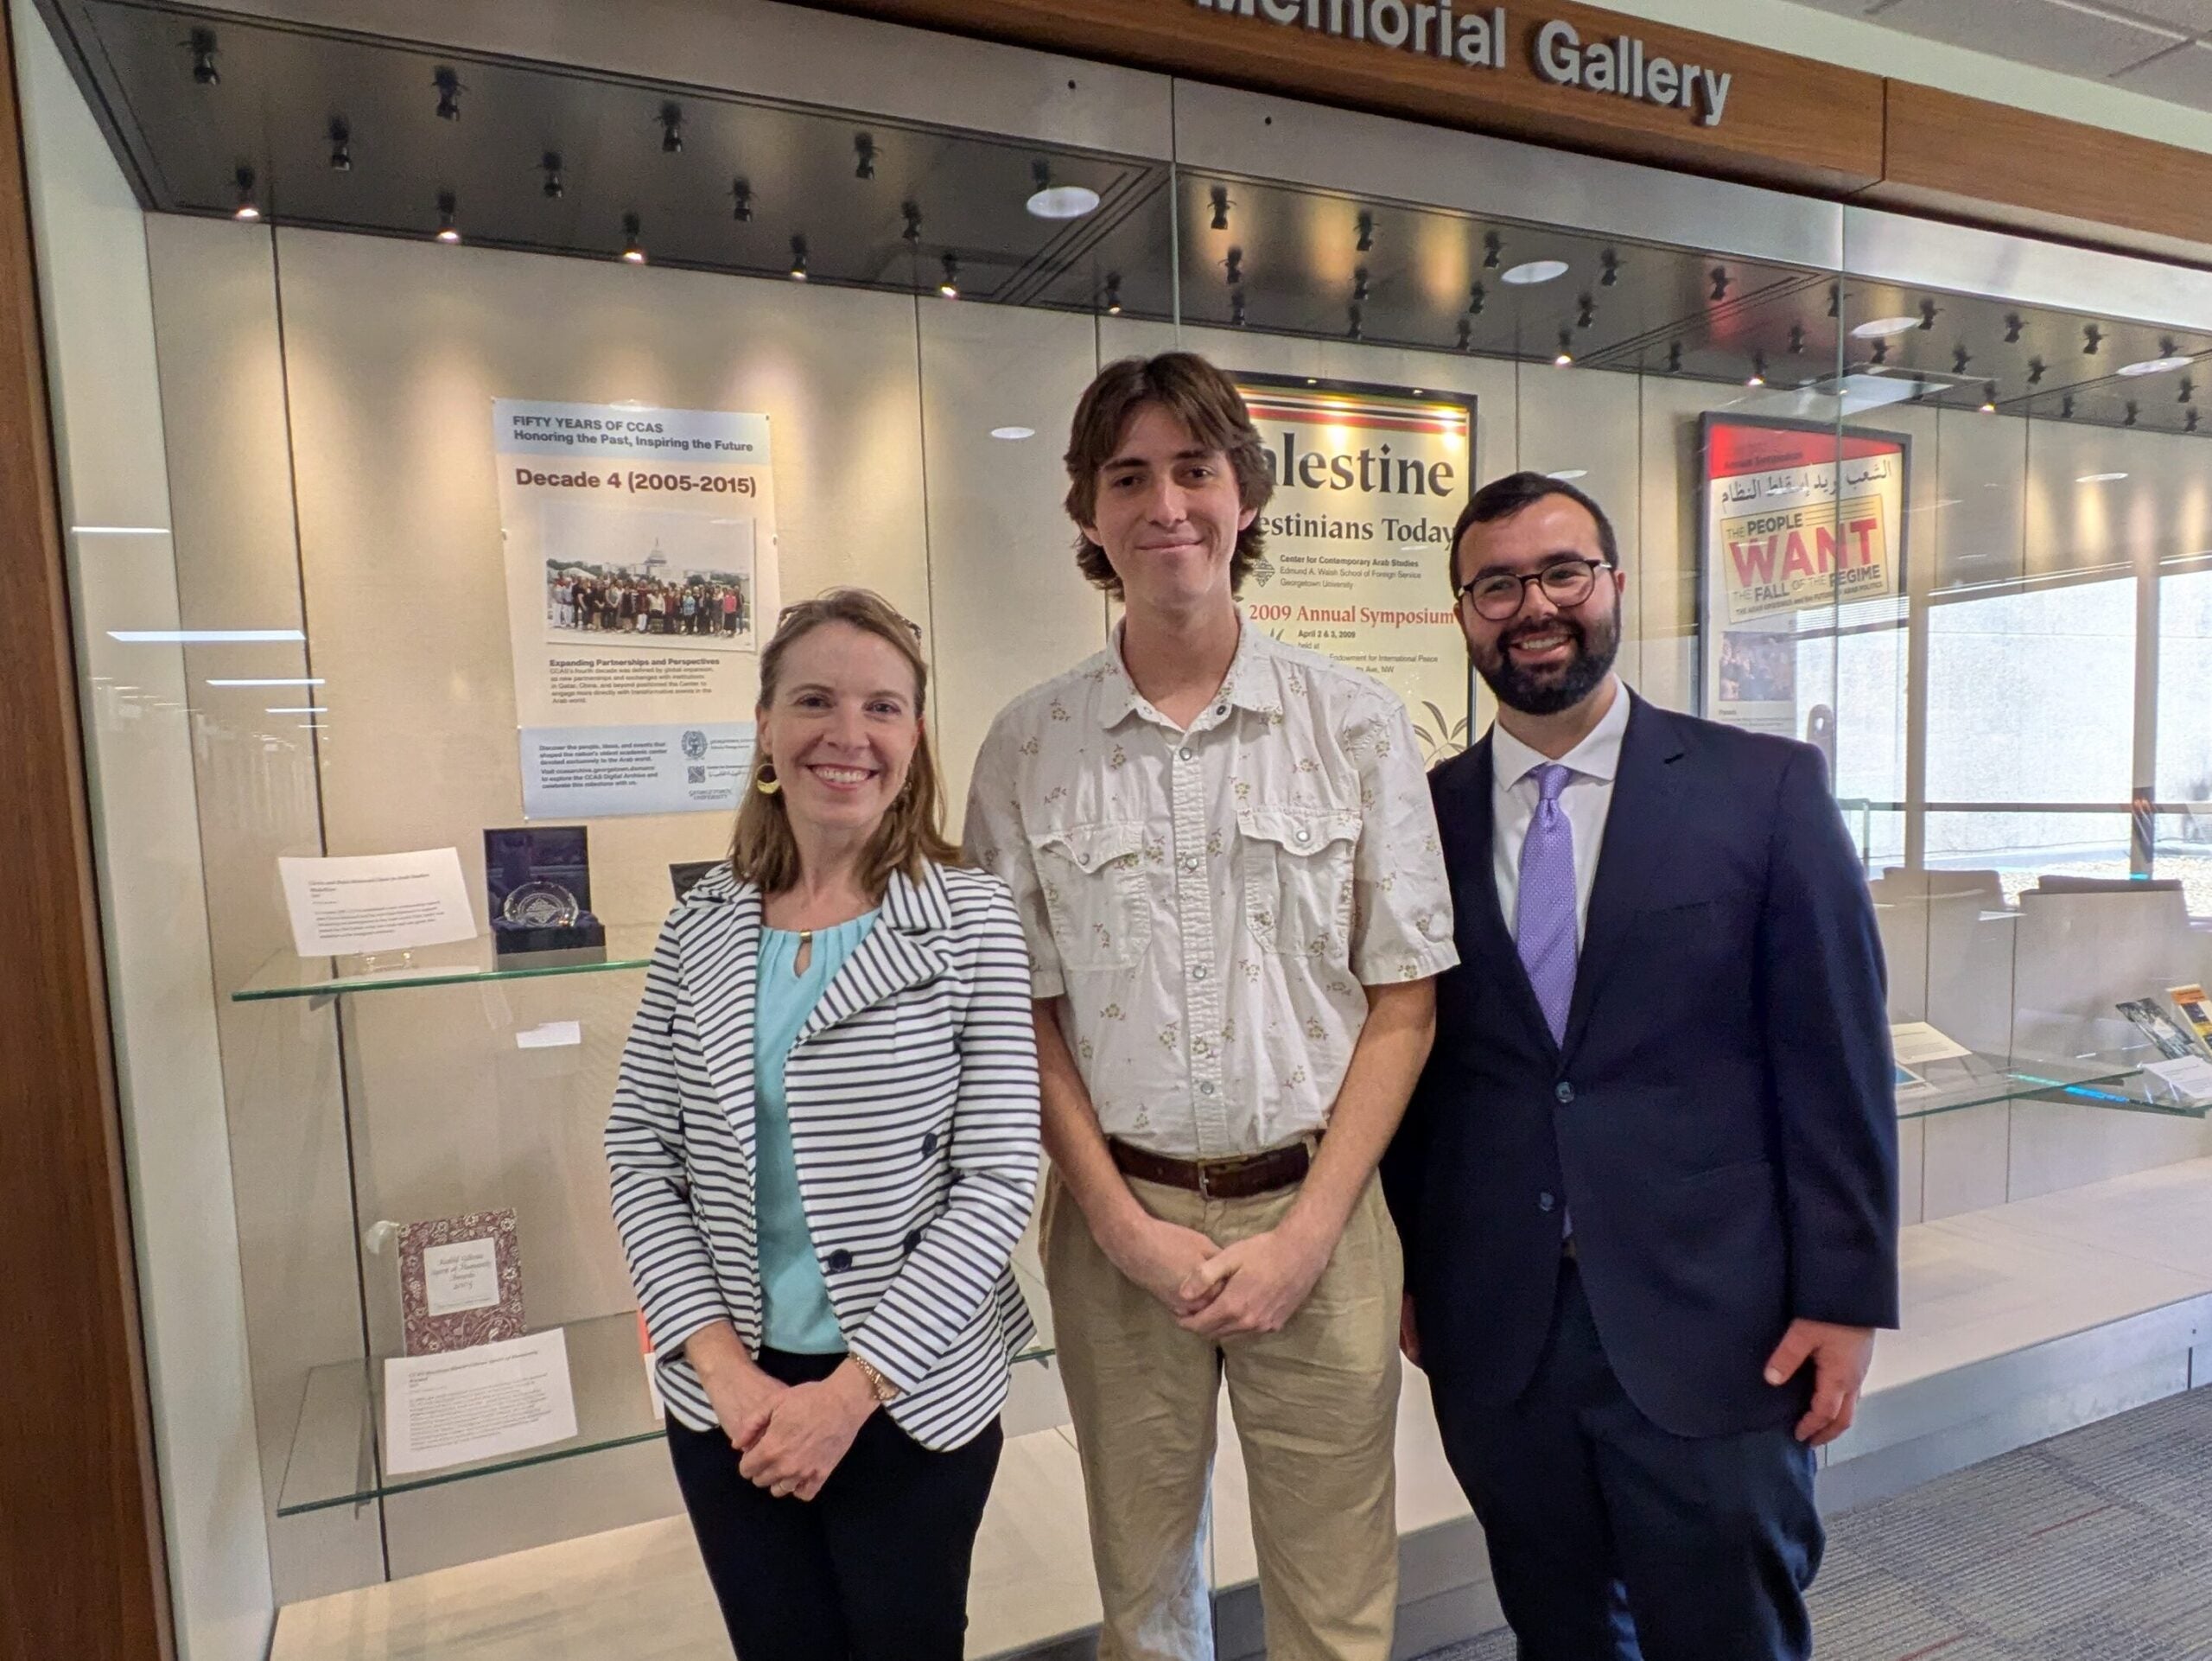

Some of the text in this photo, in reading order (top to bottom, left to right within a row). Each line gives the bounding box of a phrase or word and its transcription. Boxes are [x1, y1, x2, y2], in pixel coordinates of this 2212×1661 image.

[1539, 20, 1731, 126] Gallery
[512, 416, 664, 433] FIFTY YEARS OF CCAS
[513, 430, 753, 452] Honoring the Past, Inspiring the Future
[516, 468, 757, 498] Decade 4 (2005-2015)
[1258, 512, 1457, 550] estinians Today
[1726, 513, 1803, 539] THE PEOPLE
[1319, 556, 1370, 567] Contemporary
[1729, 518, 1878, 589] WANT
[1280, 566, 1307, 575] Edmund
[1754, 582, 1790, 602] FALL
[1249, 604, 1454, 628] 2009 Annual Symposium
[1298, 629, 1315, 639] April
[550, 659, 594, 668] Expanding
[596, 659, 649, 667] Partnerships
[668, 658, 720, 666] Perspectives
